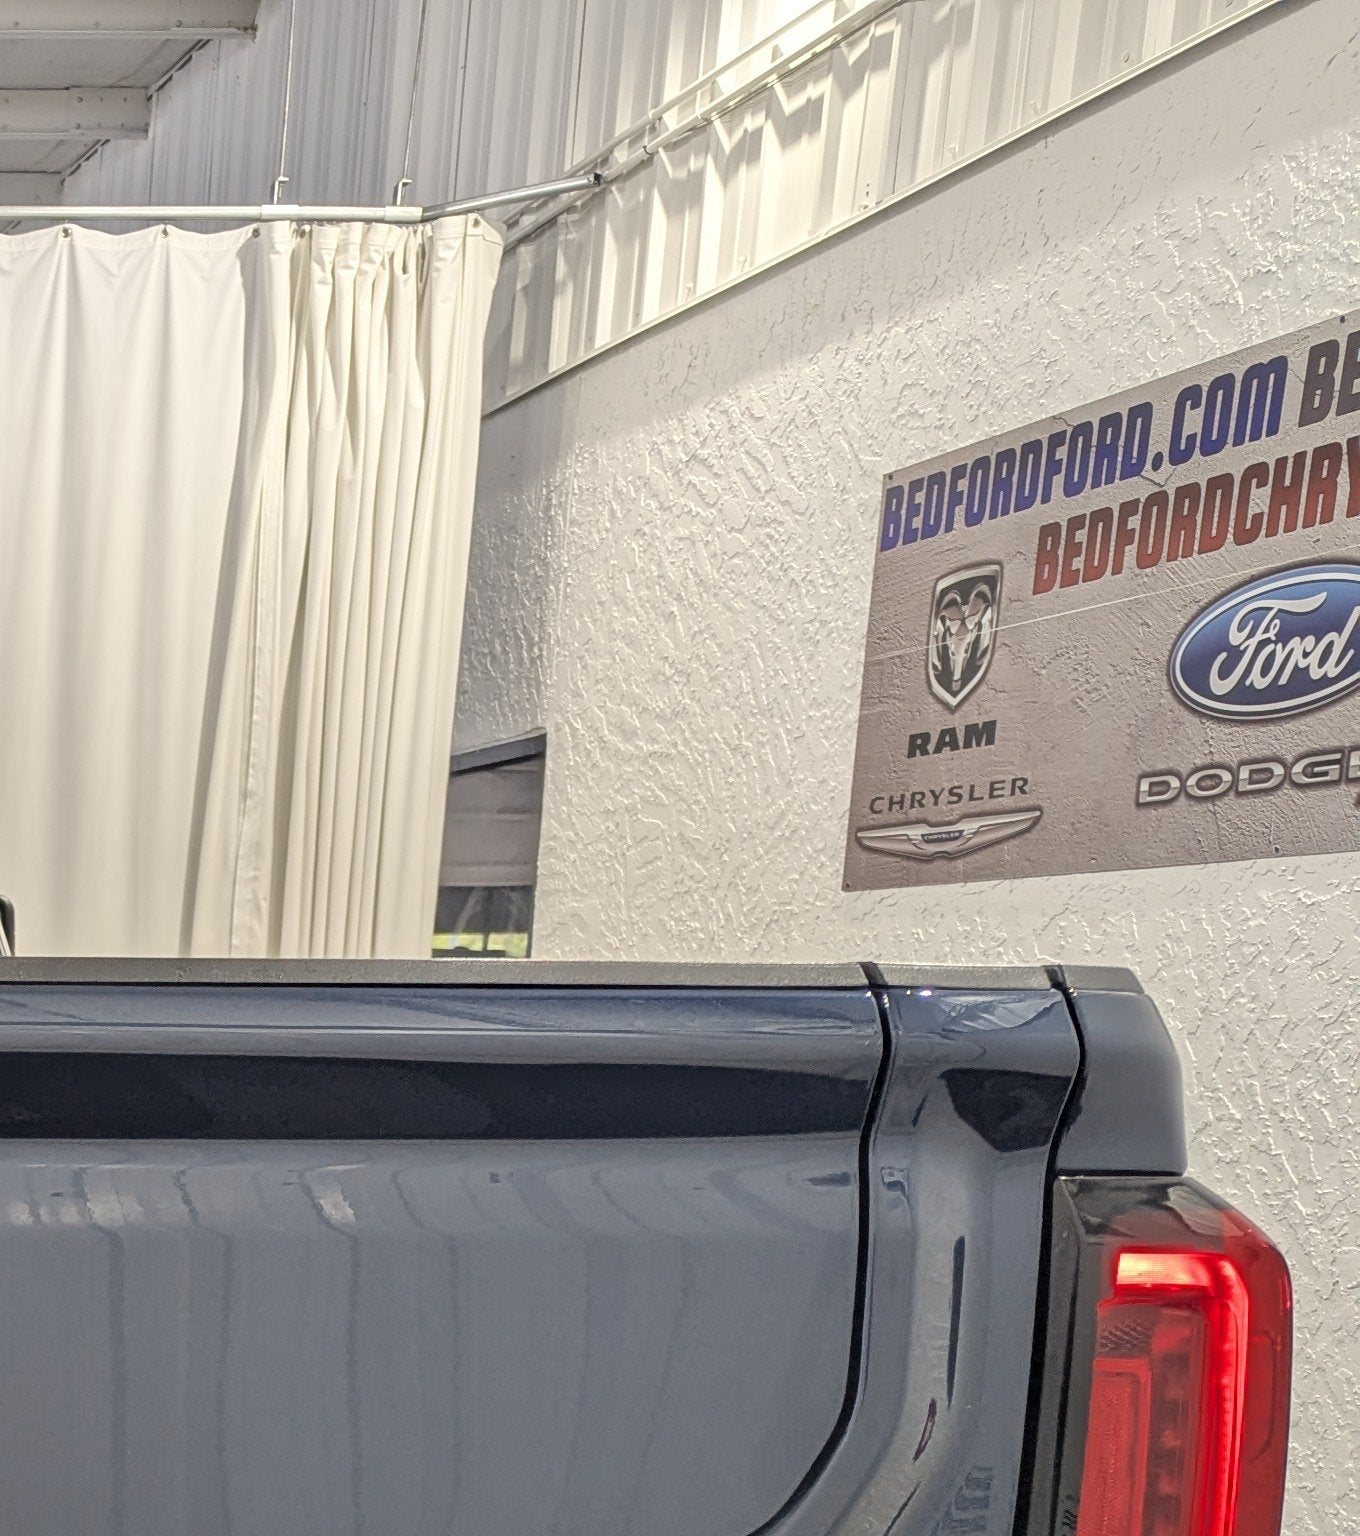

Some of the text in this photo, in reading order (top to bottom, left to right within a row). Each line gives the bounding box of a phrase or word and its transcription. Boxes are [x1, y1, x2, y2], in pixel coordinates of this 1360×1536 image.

[881, 354, 1289, 552] BEDFORDFORD.COM
[1209, 591, 1360, 696] Ford
[907, 719, 998, 759] RAM
[869, 777, 1029, 814] CHRYSLER
[1138, 750, 1360, 804] DODG
